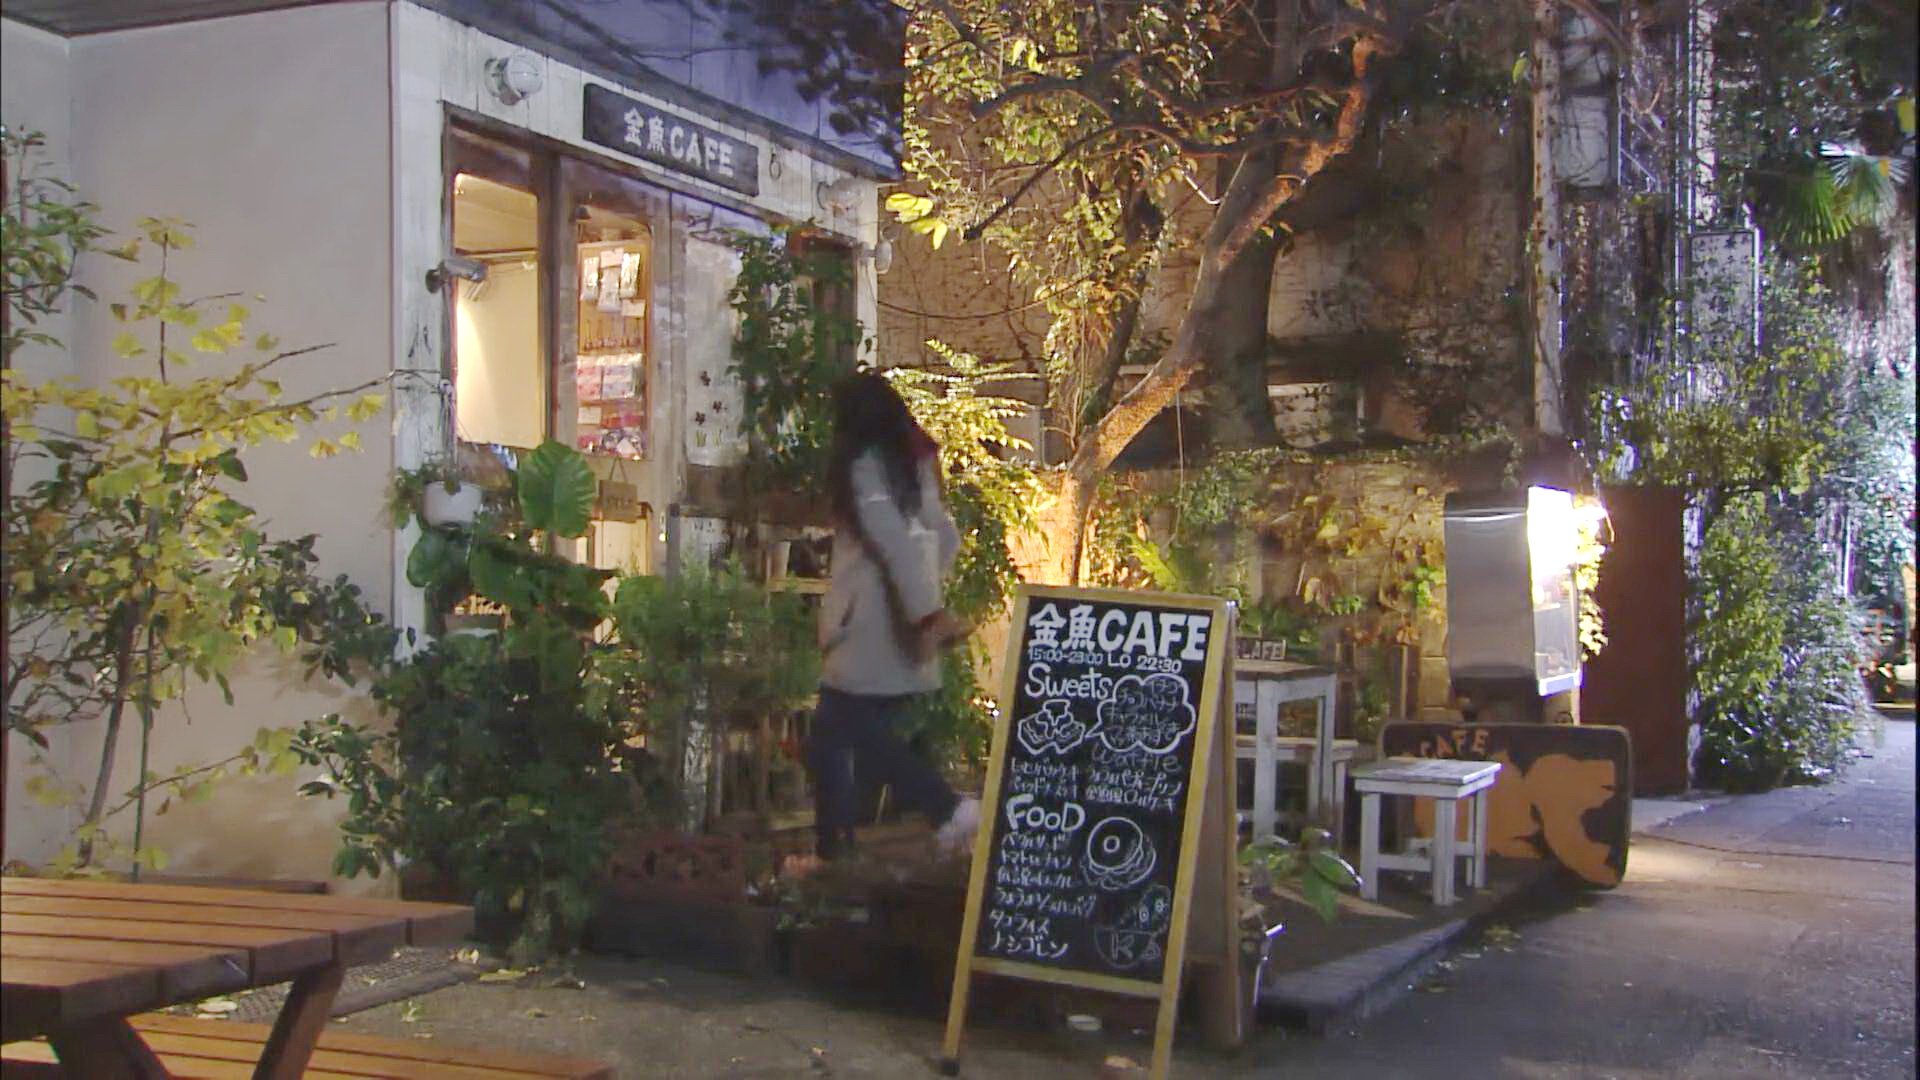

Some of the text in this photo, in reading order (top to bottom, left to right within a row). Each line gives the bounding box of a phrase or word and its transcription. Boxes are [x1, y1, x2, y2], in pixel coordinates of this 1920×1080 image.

[623, 107, 734, 178] 金魚CAFE
[1028, 602, 1210, 661] 金魚CAFE
[1025, 662, 1113, 699] Sweets
[1136, 655, 1182, 675] 22:30
